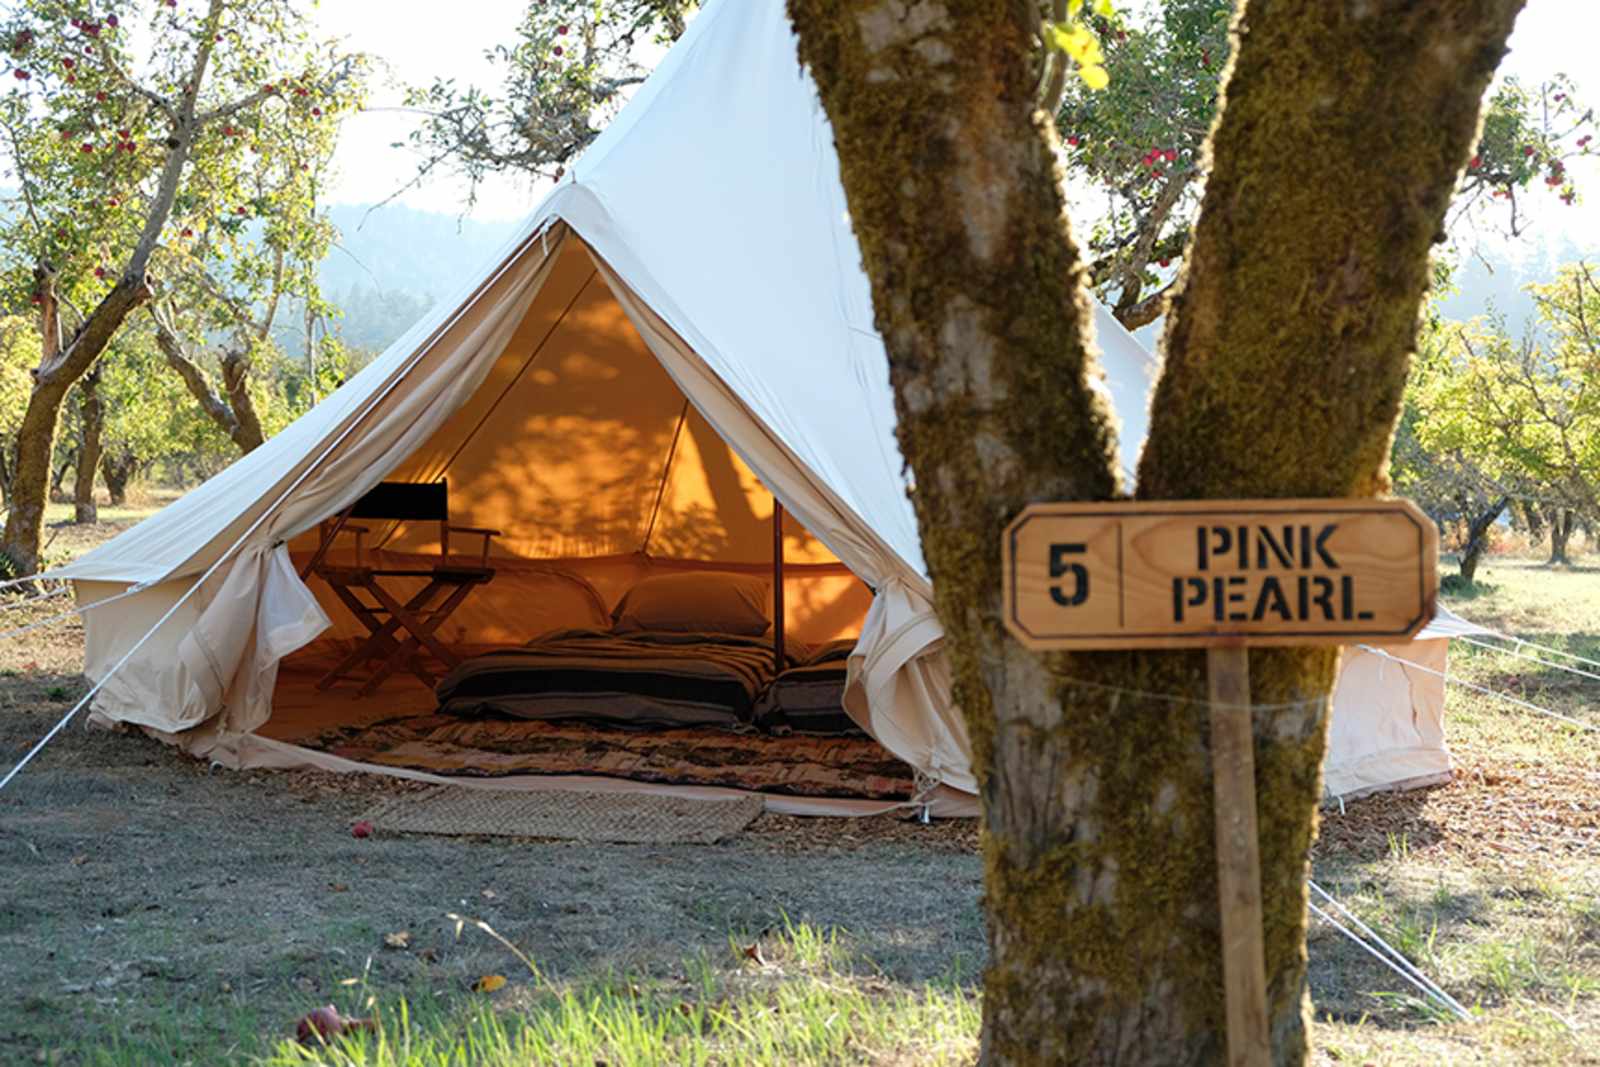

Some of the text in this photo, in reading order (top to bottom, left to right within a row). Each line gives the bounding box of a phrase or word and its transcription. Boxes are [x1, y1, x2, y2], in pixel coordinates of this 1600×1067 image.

[1196, 524, 1341, 572] PINK
[1047, 542, 1090, 607] 5
[1171, 575, 1376, 623] PEARL
